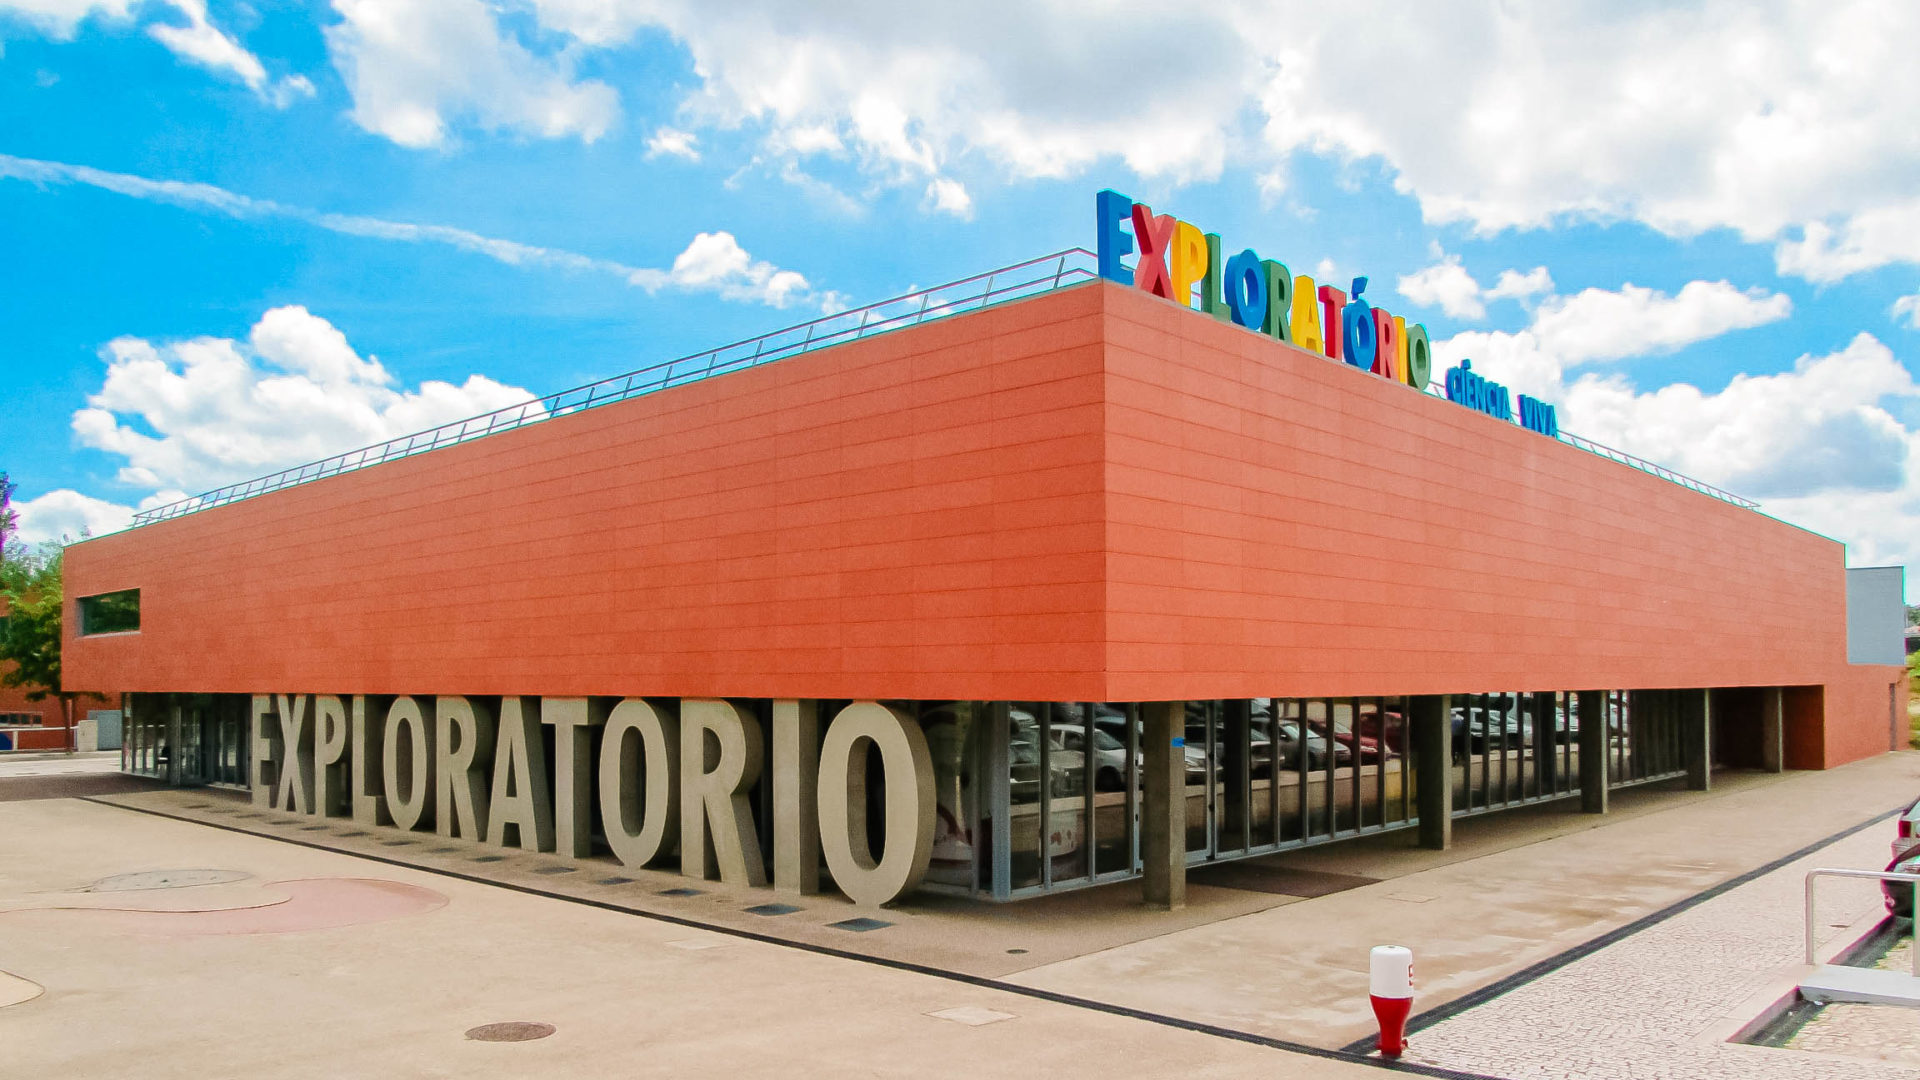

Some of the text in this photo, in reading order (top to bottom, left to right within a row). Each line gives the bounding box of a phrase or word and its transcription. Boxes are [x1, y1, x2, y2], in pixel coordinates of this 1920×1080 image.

[1096, 188, 1431, 391] EXPLORATÓRIO
[1517, 394, 1558, 438] VIVA
[250, 694, 937, 907] EXPLORATORIO
